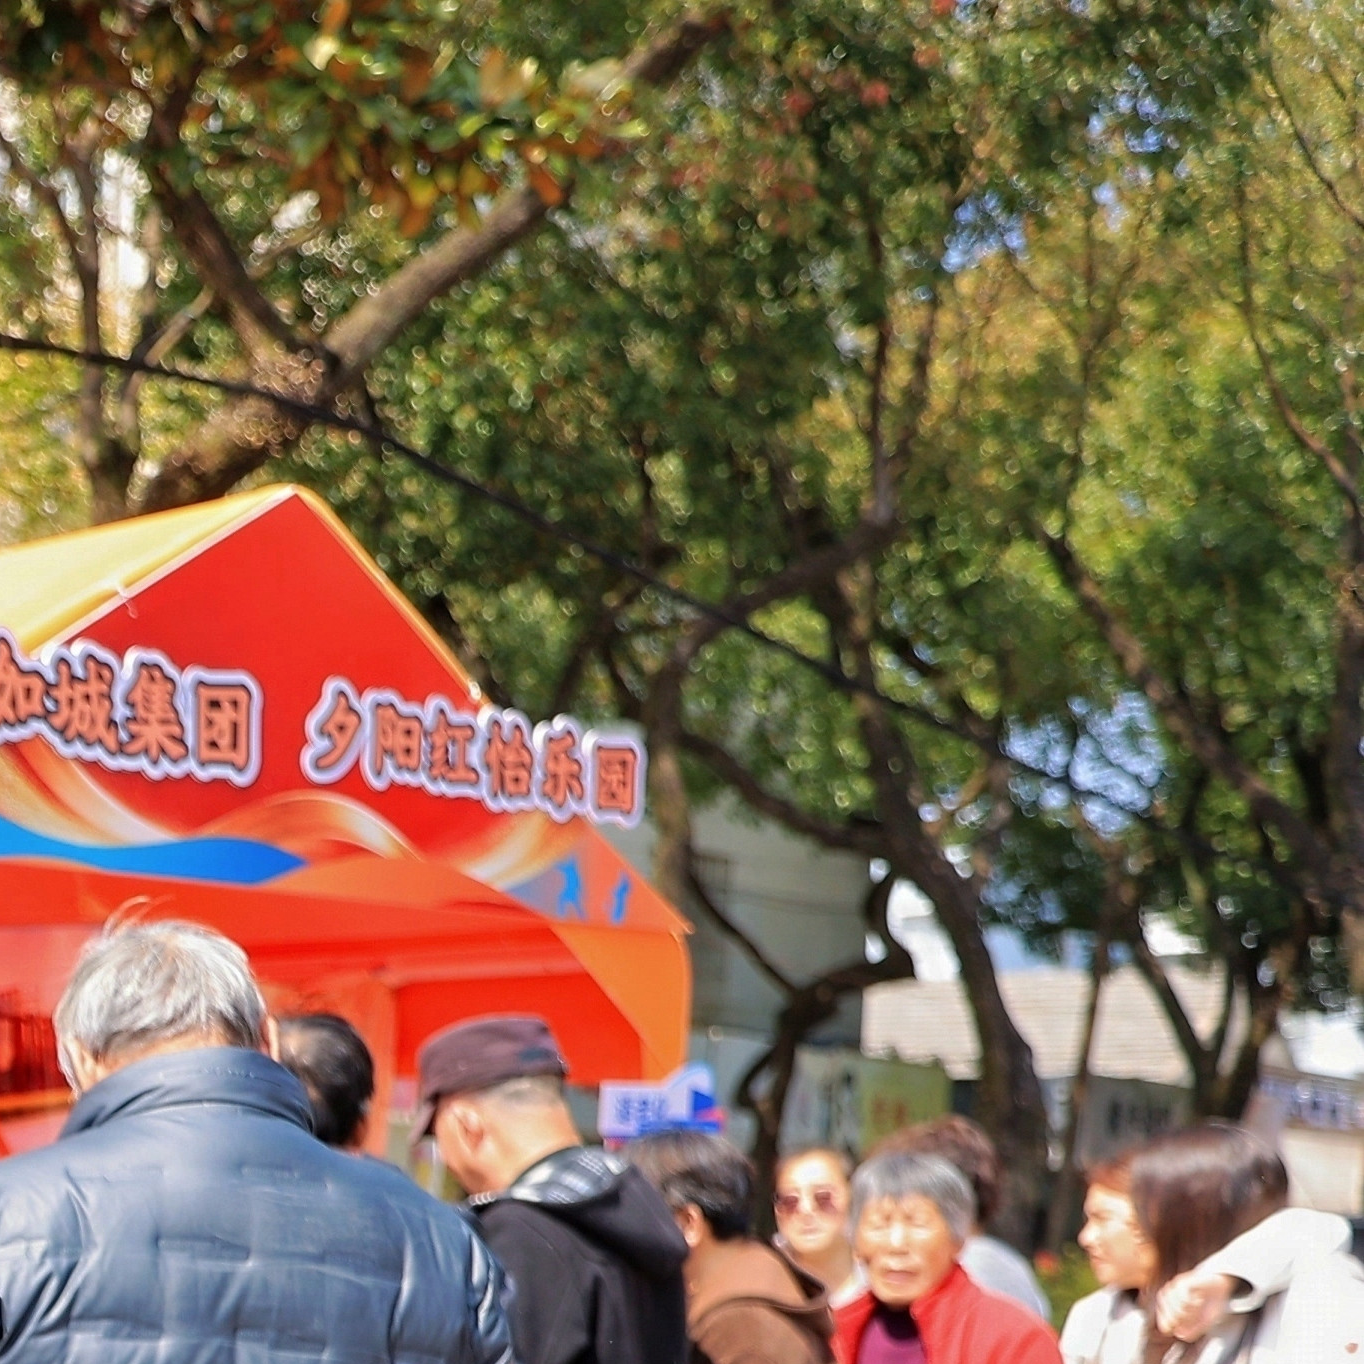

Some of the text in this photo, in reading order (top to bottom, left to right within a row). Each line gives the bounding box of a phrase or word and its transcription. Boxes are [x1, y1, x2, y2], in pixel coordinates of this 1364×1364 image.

[314, 690, 637, 814] 夕阳红怡乐园
